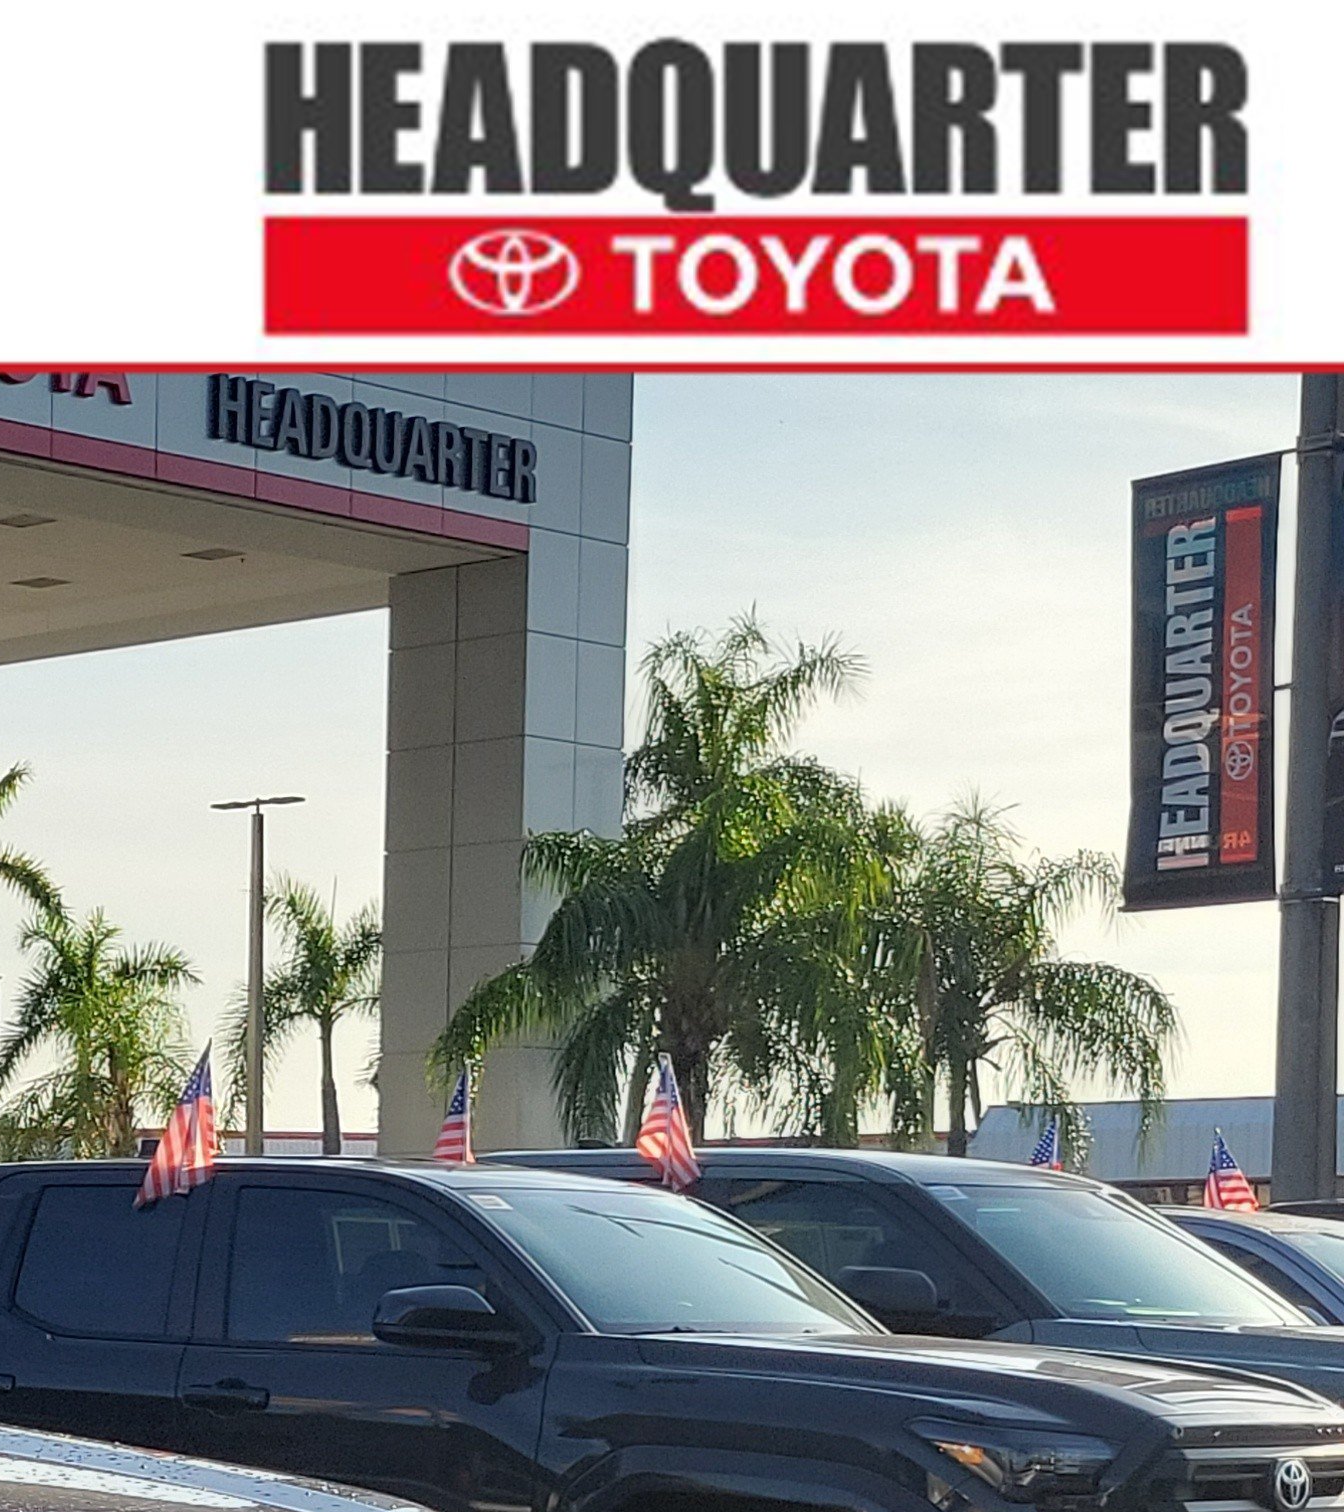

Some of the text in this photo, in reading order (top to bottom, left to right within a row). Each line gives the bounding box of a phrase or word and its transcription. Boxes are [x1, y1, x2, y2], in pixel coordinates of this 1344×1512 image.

[209, 374, 537, 503] HEADQUARTER
[1157, 516, 1219, 871] HEADQUARTER
[1229, 603, 1253, 738] TOYOTA
